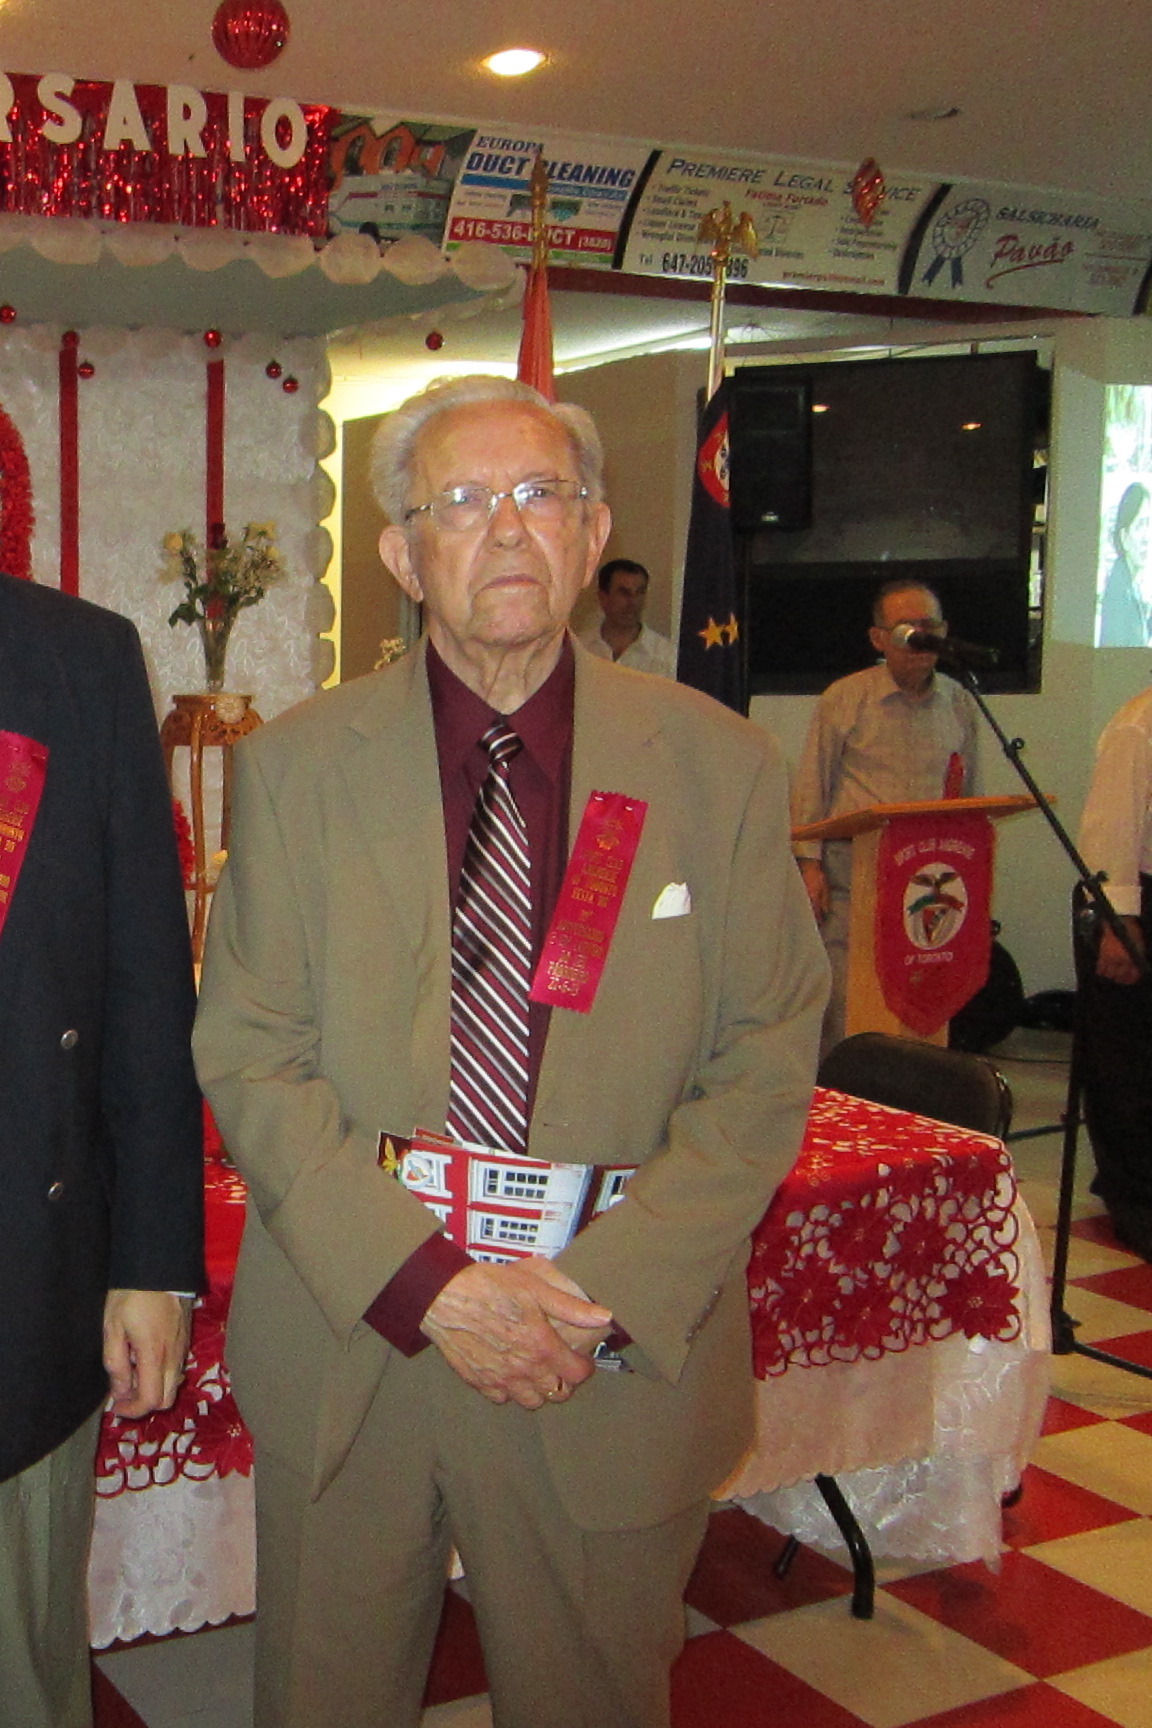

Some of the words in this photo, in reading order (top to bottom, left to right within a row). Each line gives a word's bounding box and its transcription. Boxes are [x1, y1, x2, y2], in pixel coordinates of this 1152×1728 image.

[466, 152, 530, 176] DUCT
[666, 157, 766, 184] PREMIERE
[773, 170, 834, 194] LEGAL
[843, 181, 923, 202] SVICE
[454, 221, 576, 246] 416-536-CT
